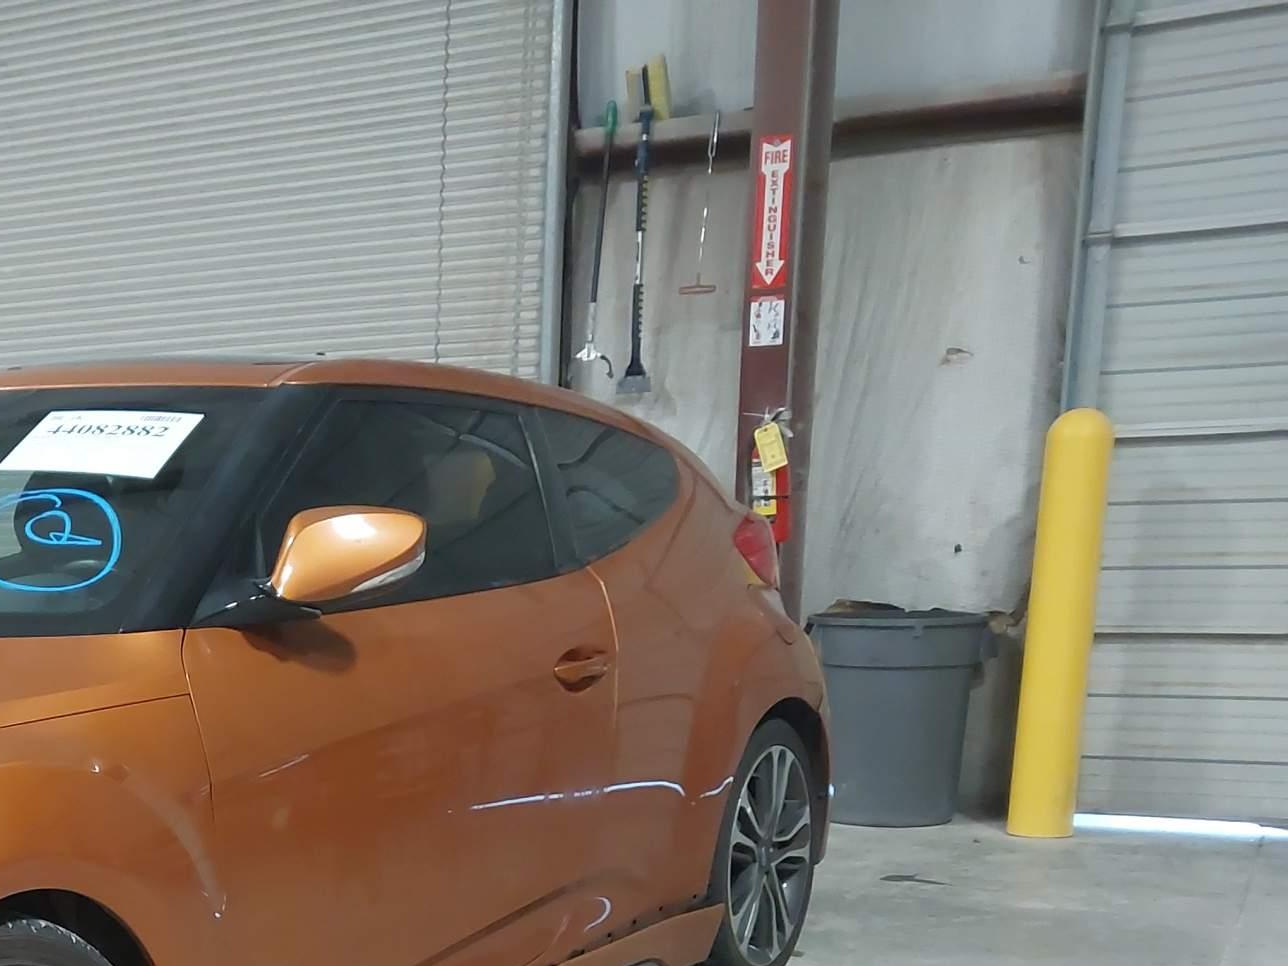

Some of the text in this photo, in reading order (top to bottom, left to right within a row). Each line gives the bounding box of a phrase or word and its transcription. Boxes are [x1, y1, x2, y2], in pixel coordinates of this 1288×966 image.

[764, 149, 789, 165] FIRE
[765, 170, 779, 276] EXTINGUISHER
[48, 423, 169, 437] 44082882
